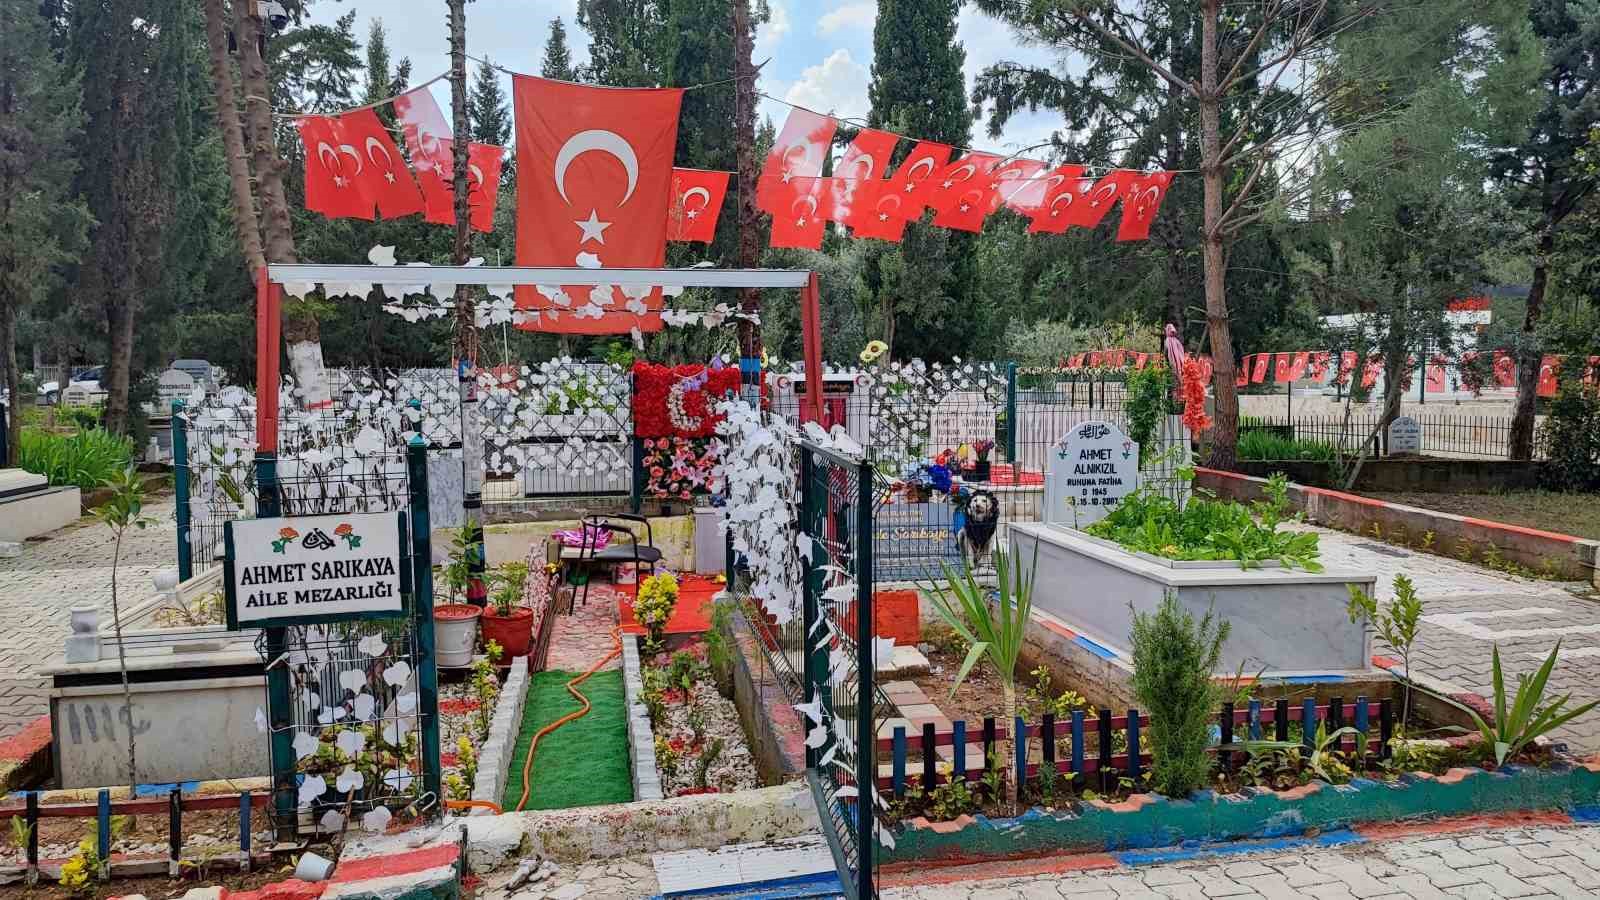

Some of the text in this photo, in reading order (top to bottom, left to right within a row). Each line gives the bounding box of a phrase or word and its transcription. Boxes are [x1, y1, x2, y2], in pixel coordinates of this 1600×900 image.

[1079, 448, 1112, 460] AHMET
[1074, 463, 1117, 475] ALNIKIZIL
[1067, 478, 1097, 486] RUHUNA
[1092, 487, 1107, 496] 1945
[240, 557, 395, 586] AHMET SARIKAYA
[245, 581, 393, 608] AİLE MEZARLIĞI
